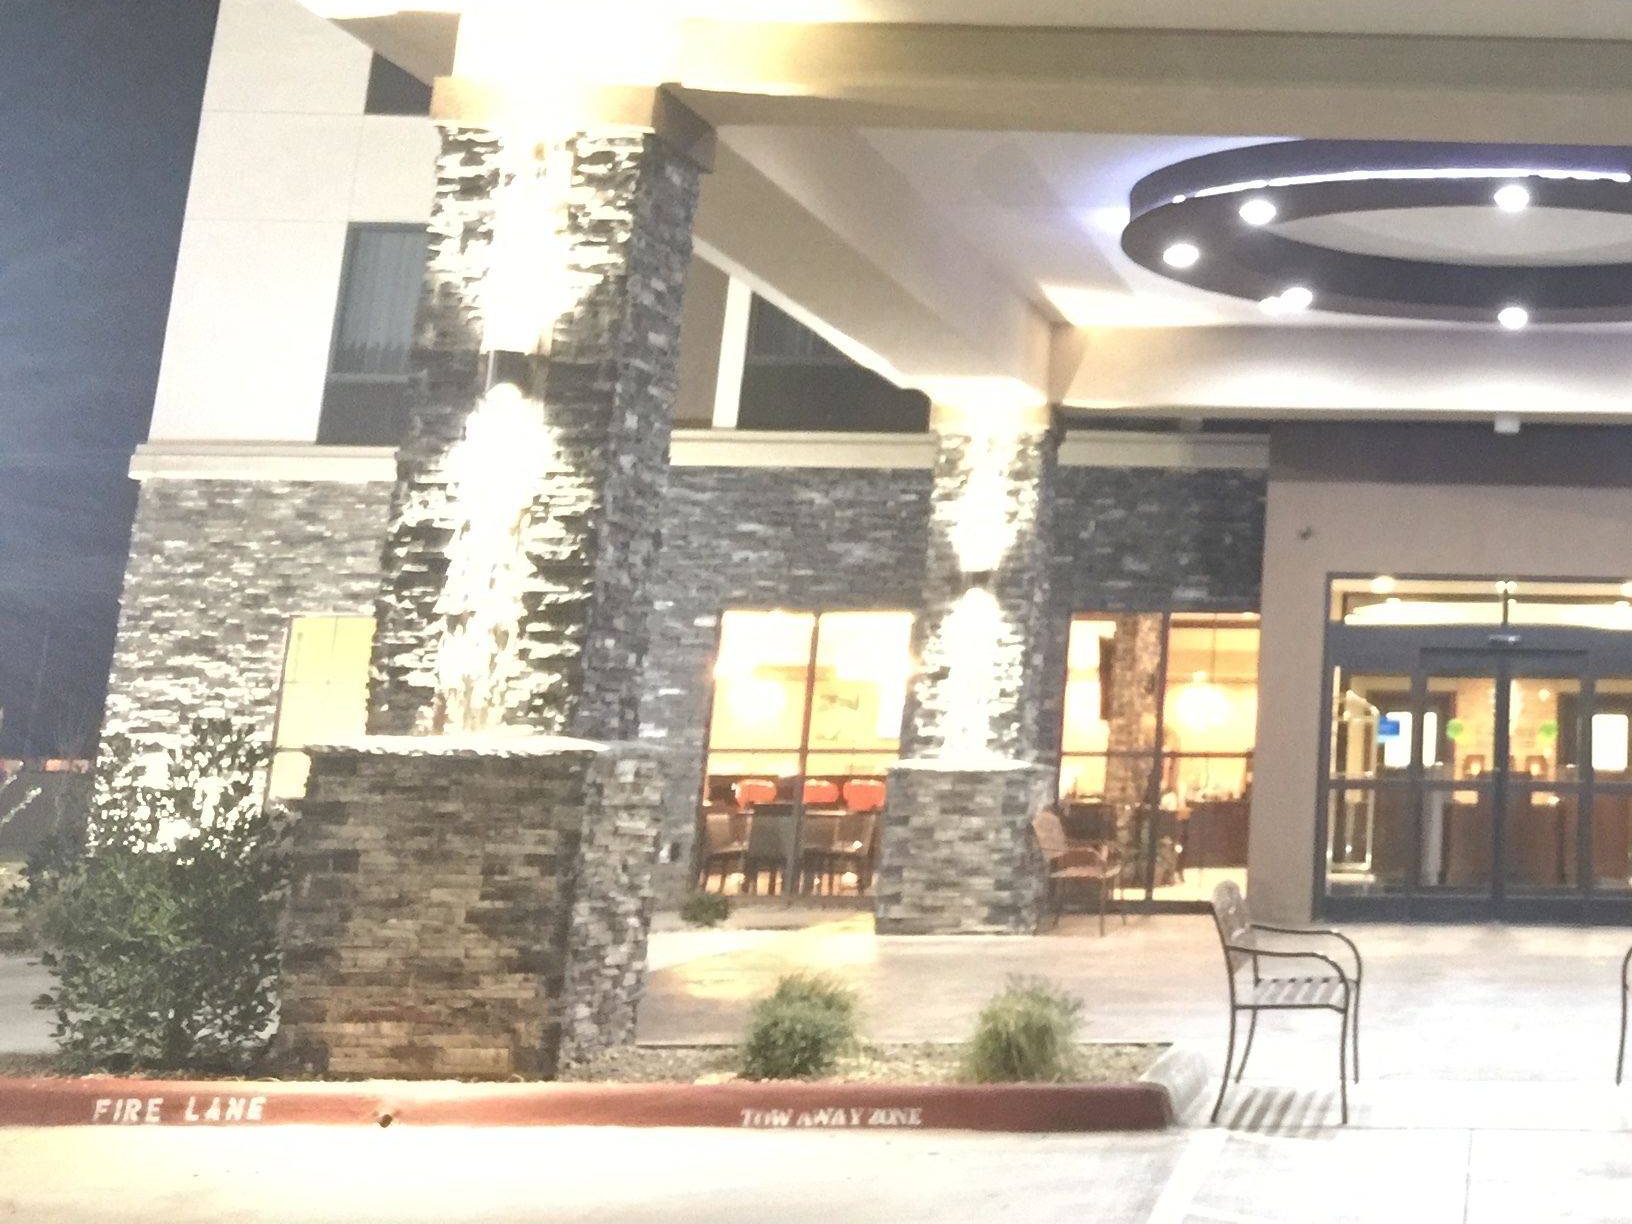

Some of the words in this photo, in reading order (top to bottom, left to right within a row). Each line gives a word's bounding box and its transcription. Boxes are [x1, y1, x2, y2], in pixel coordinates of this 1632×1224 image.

[92, 1097, 164, 1123] FIRE
[184, 1096, 267, 1122] LANE
[796, 1108, 864, 1126] AWAY
